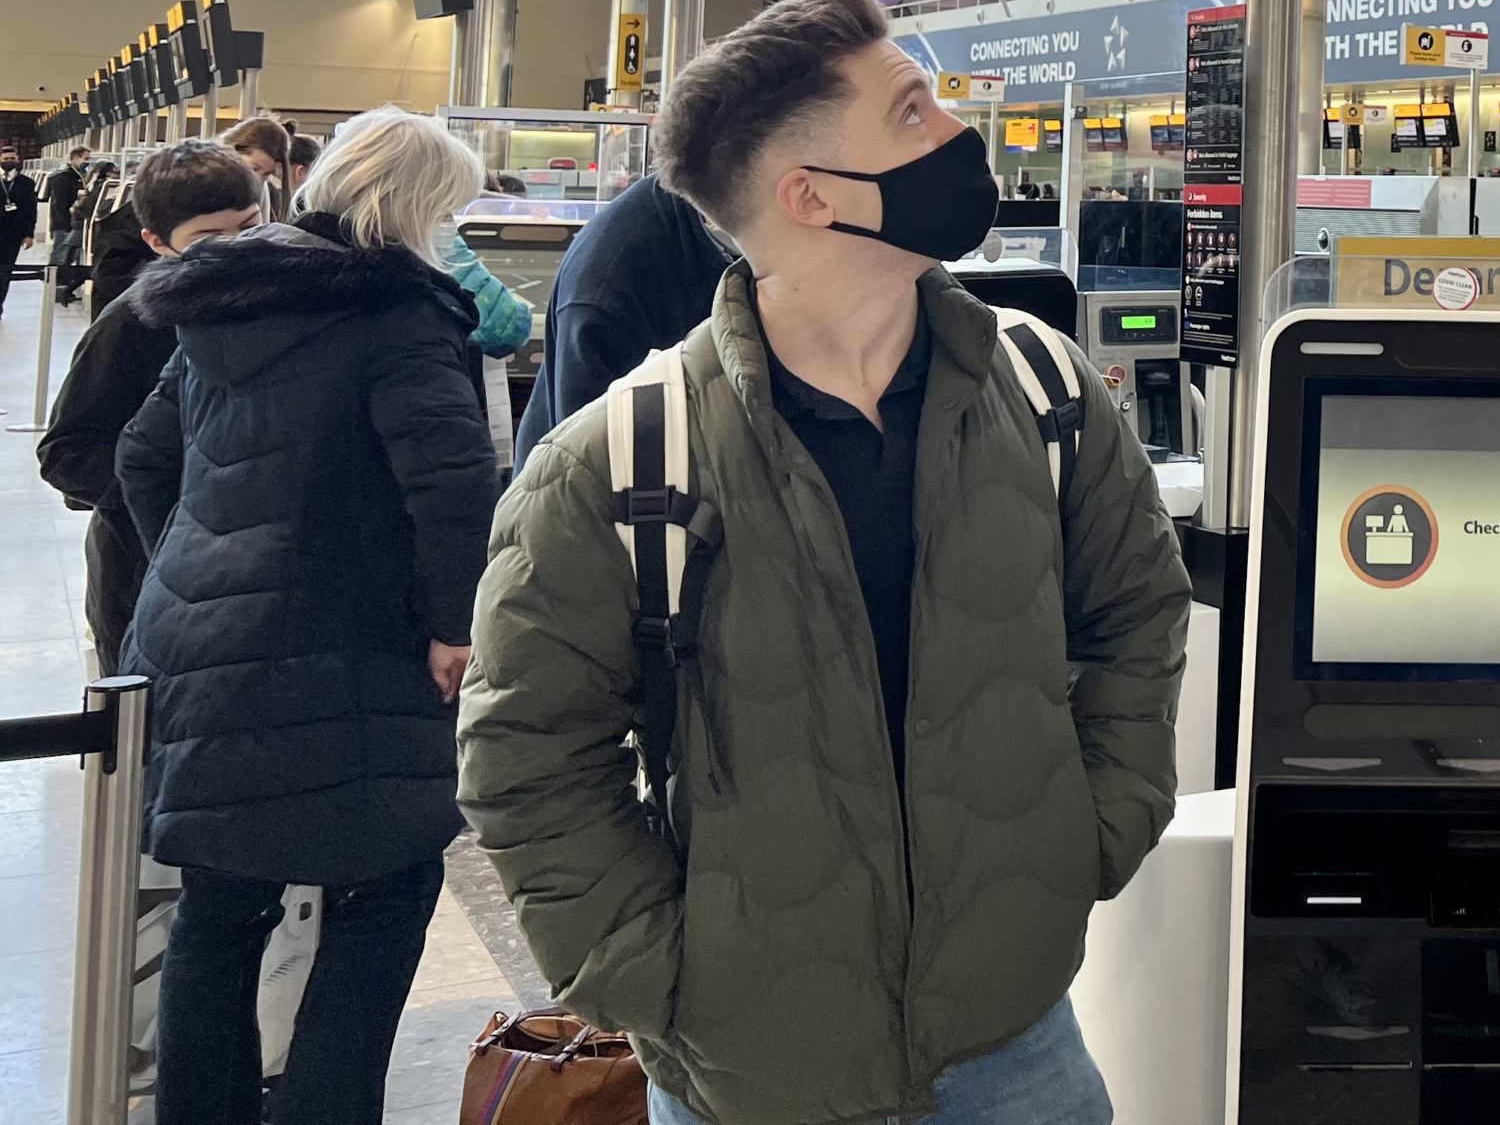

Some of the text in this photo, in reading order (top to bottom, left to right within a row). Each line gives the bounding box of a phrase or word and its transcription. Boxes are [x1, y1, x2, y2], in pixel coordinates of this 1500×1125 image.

[970, 30, 1080, 62] CONNECTING YOU
[1355, 29, 1398, 57] THE
[1003, 61, 1076, 86] THE WORLD
[1187, 208, 1209, 219] Forbidden
